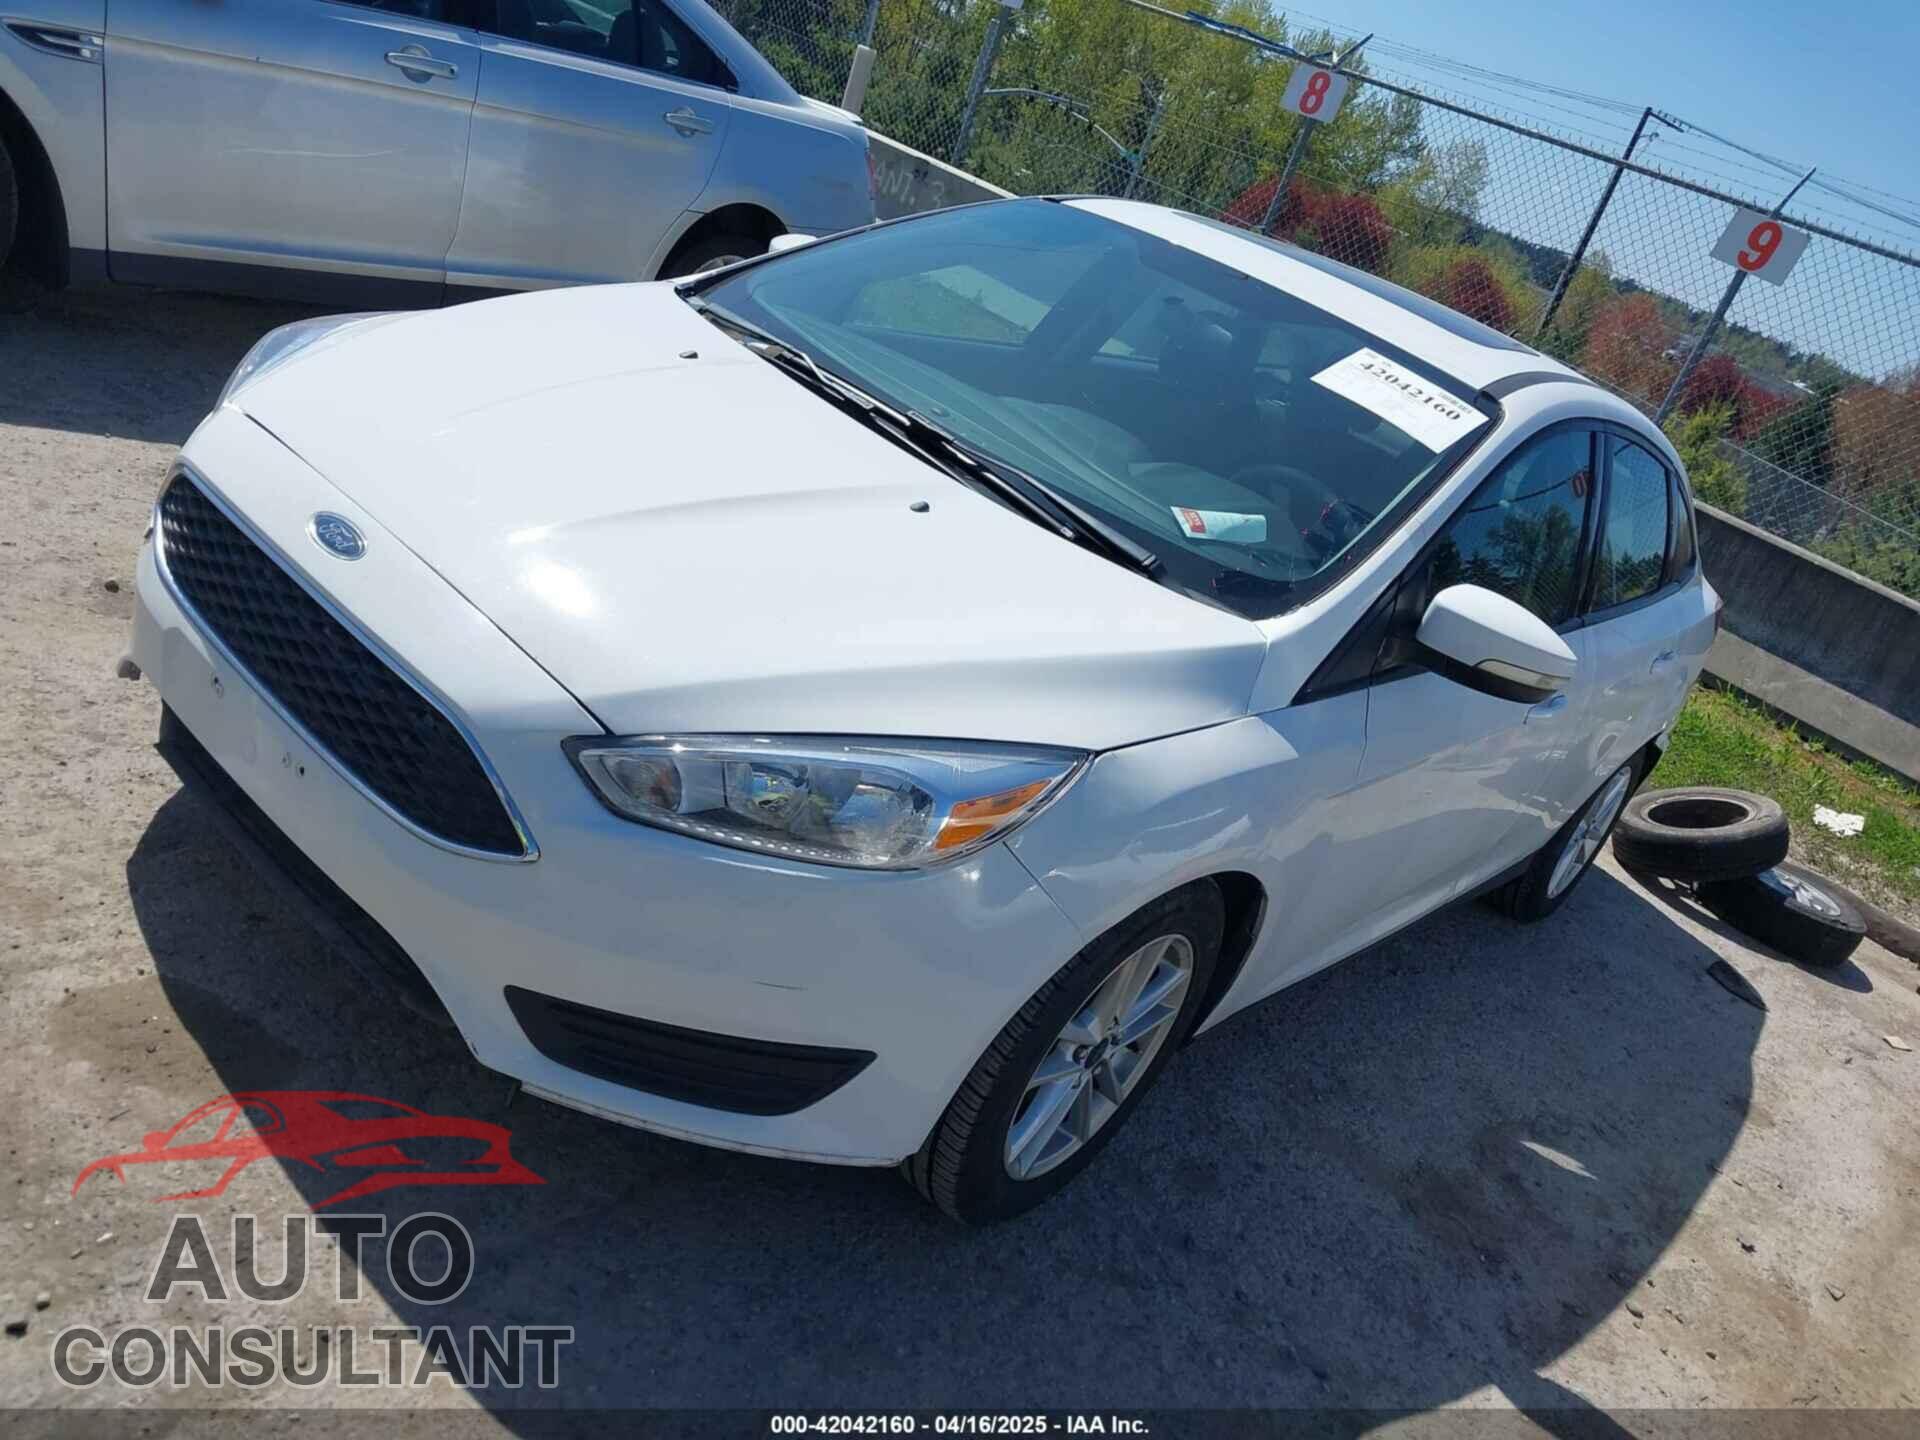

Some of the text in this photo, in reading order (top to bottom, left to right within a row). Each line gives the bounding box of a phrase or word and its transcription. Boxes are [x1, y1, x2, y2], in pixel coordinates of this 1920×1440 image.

[1299, 71, 1331, 115] 8
[1737, 220, 1783, 272] 9
[1359, 361, 1461, 421] 42042160
